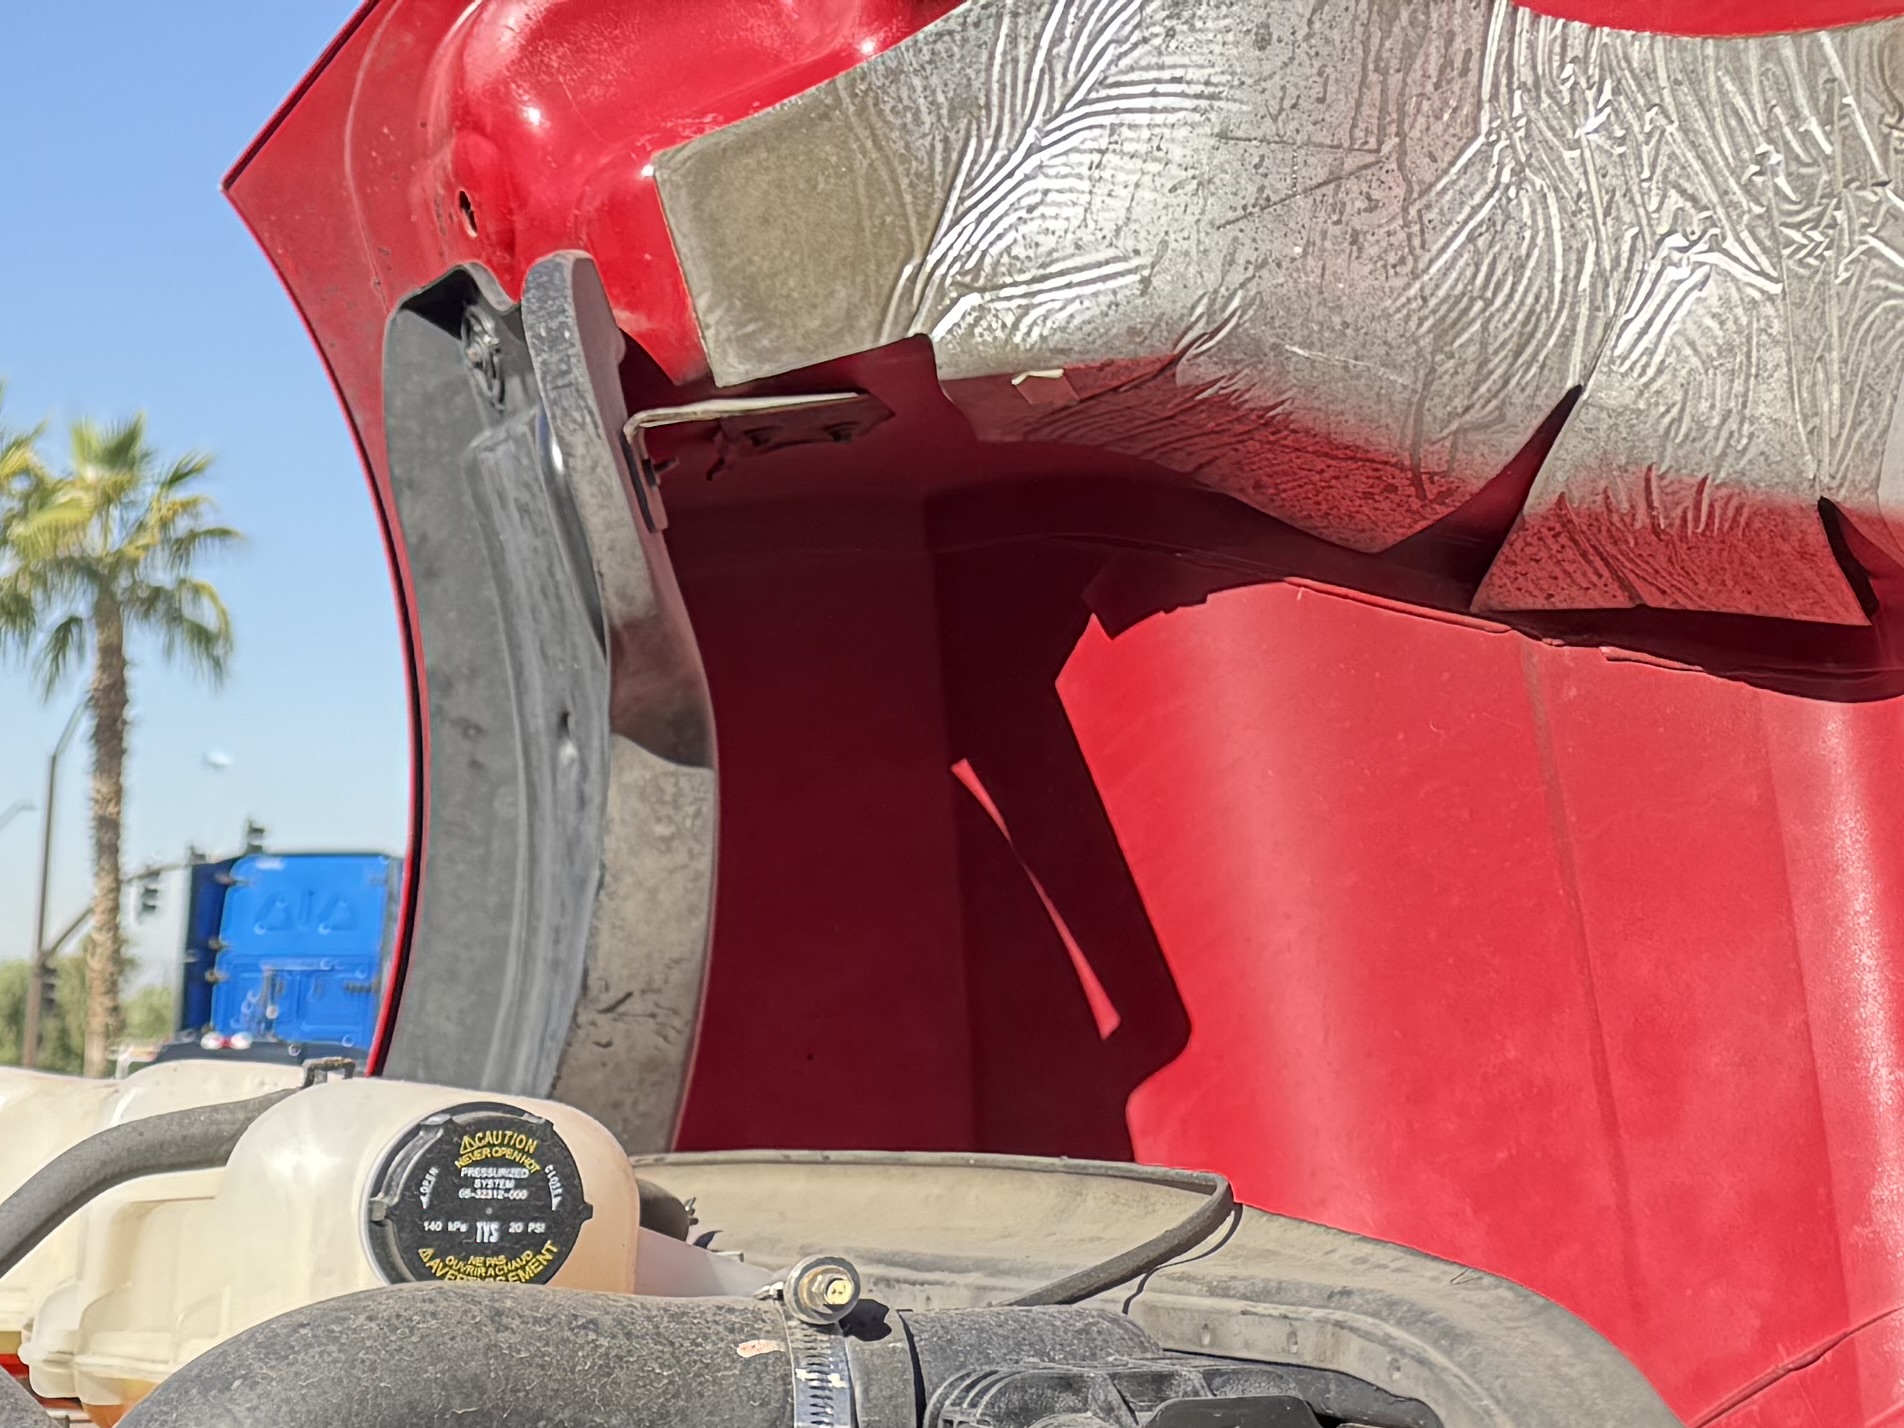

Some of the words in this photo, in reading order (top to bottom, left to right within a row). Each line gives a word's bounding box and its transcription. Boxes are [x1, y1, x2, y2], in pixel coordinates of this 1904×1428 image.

[475, 1130, 538, 1153] CAUTION
[454, 1147, 491, 1168] NEVER
[492, 1147, 521, 1161] OPEN
[460, 1168, 529, 1179] PRESSURIZED
[474, 1179, 515, 1188] SYSTEM
[509, 1222, 523, 1233] 20
[528, 1222, 546, 1233] PSI
[445, 1255, 486, 1276] OUVRIR
[496, 1250, 533, 1275] CHAUD
[486, 1255, 507, 1267] PAS
